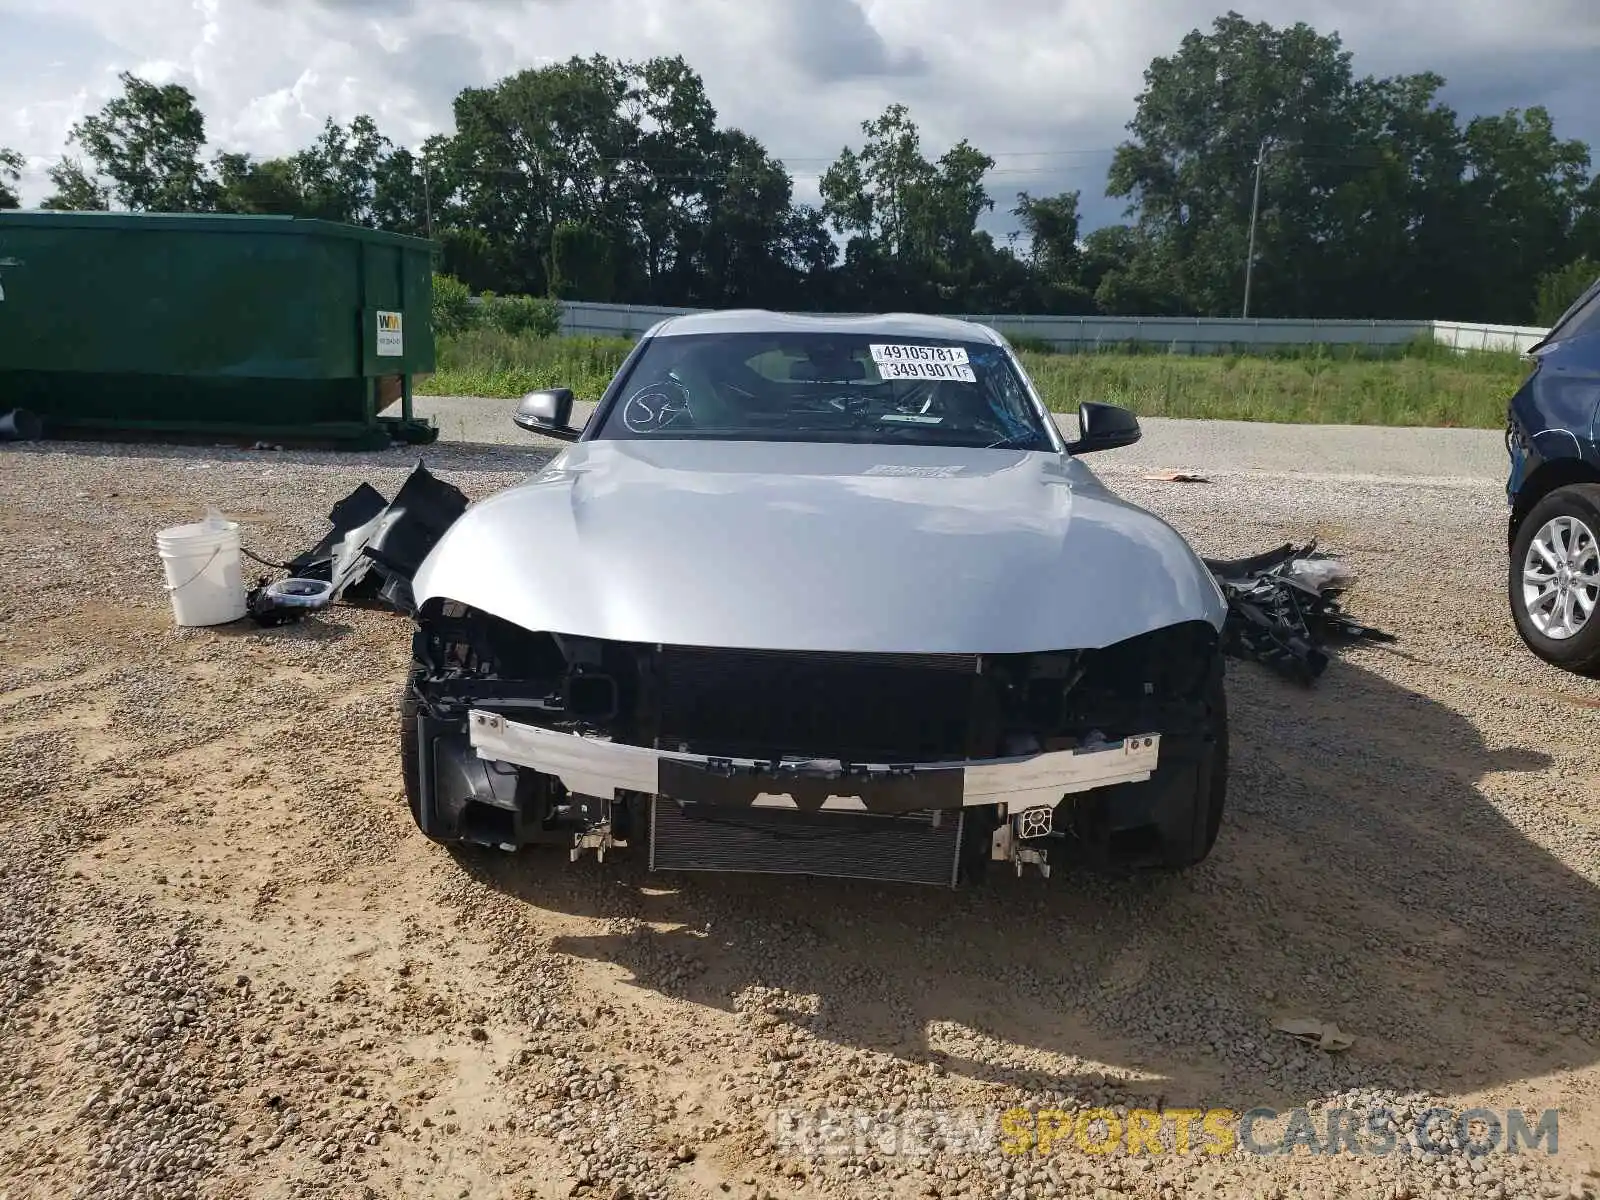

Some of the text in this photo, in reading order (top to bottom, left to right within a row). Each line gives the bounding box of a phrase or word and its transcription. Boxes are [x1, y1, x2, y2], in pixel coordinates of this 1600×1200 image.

[379, 315, 399, 328] WM
[884, 345, 954, 361] 49105781
[891, 363, 961, 378] 34919011
